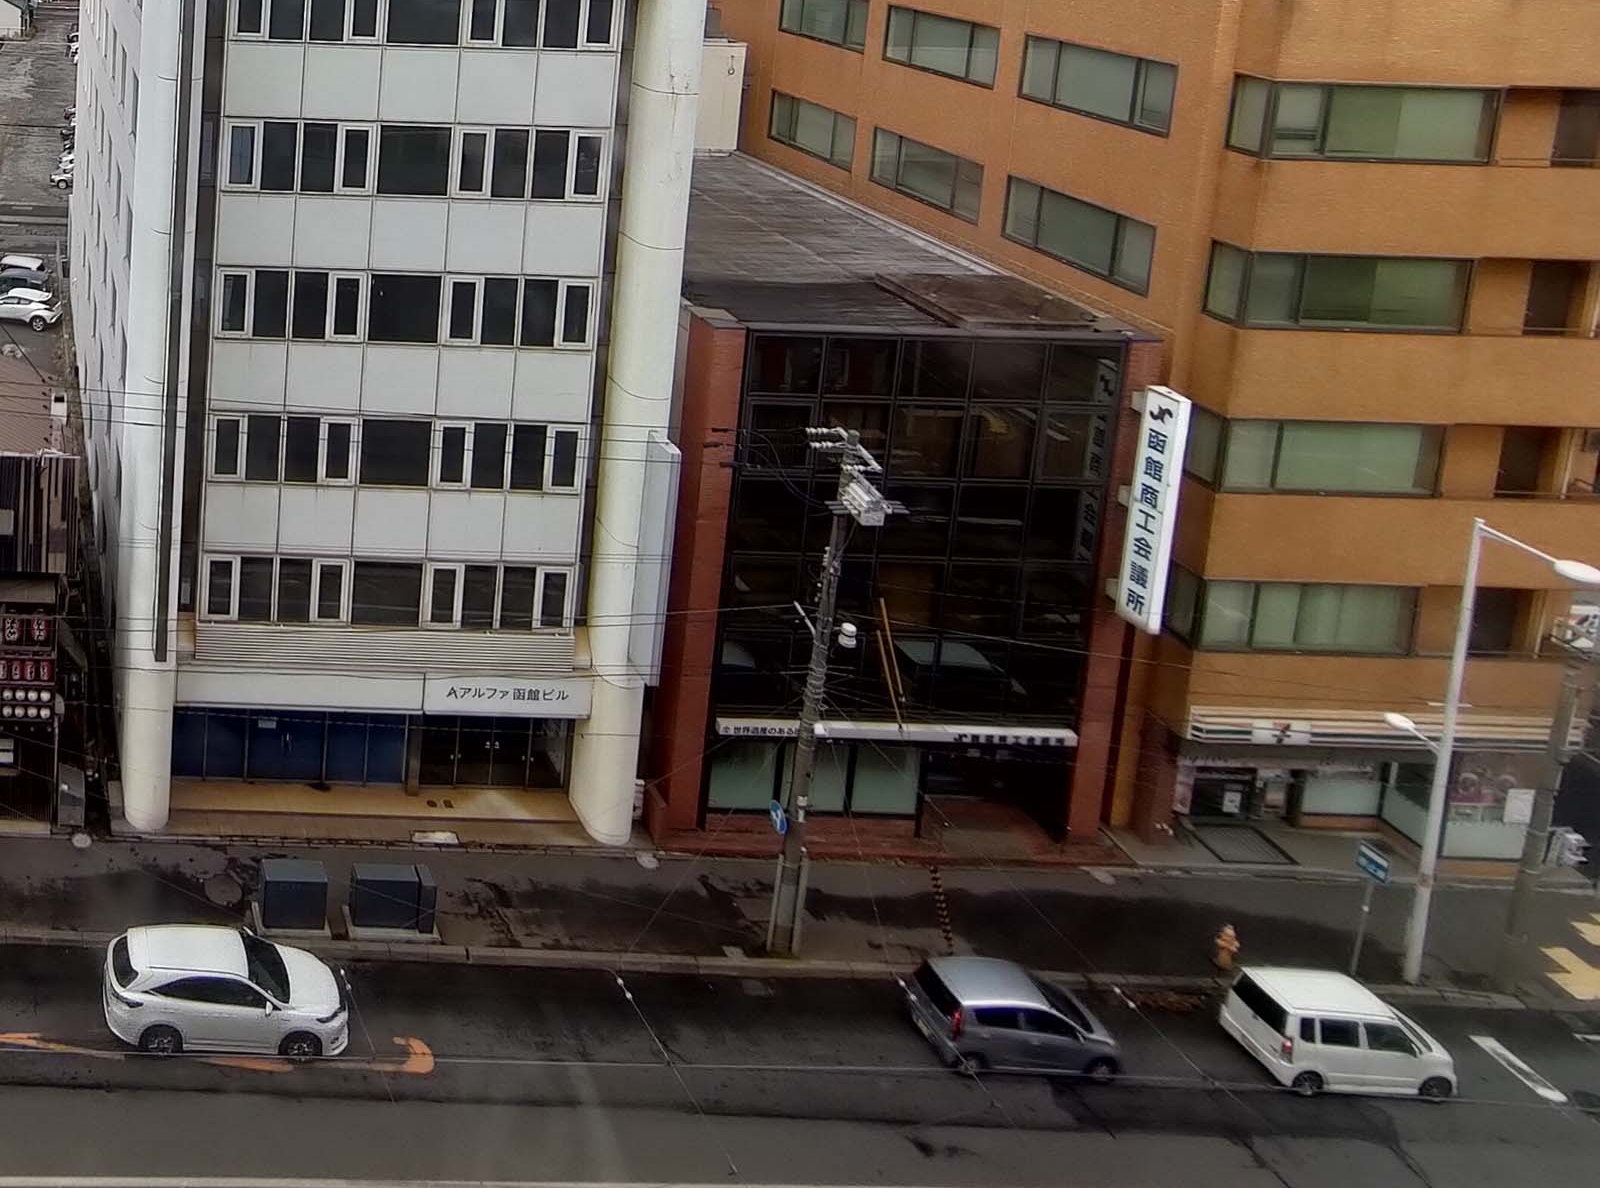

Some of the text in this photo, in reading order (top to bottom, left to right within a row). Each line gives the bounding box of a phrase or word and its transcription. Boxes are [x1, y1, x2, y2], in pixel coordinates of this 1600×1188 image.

[1126, 427, 1168, 616] 函館商工会議所
